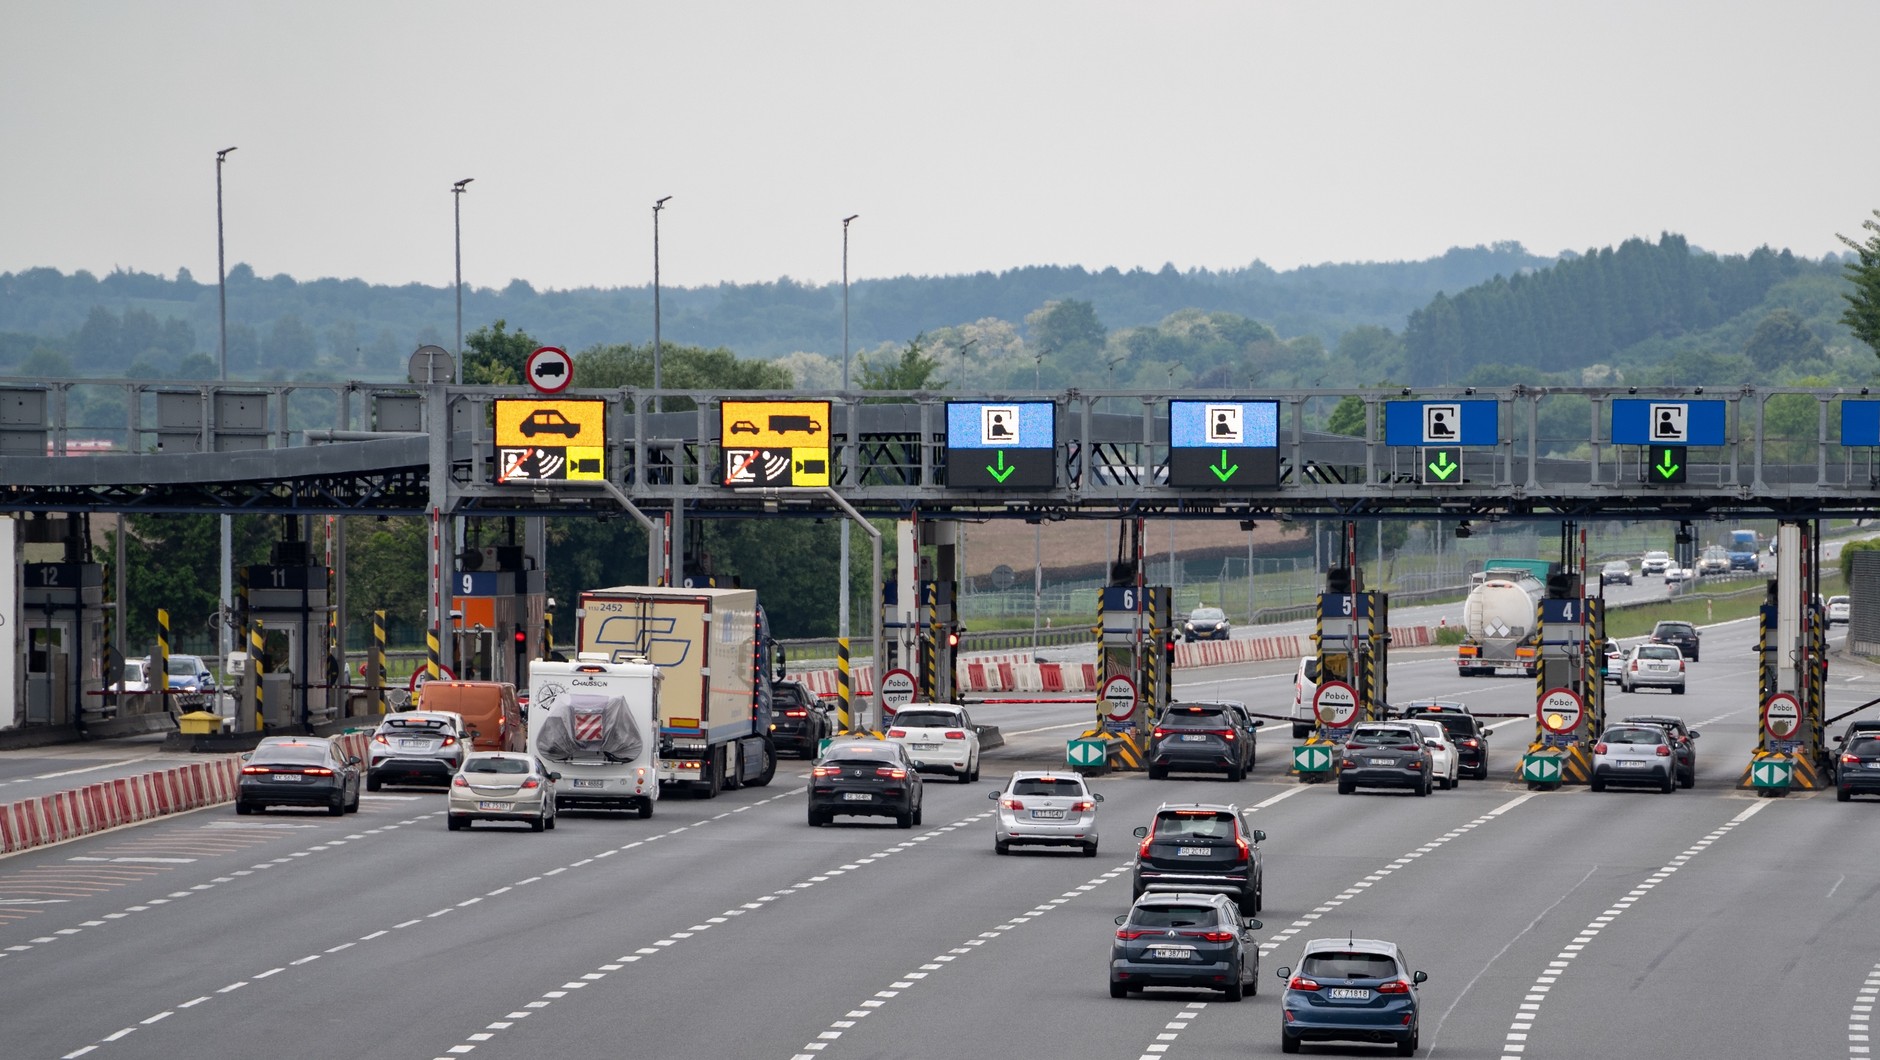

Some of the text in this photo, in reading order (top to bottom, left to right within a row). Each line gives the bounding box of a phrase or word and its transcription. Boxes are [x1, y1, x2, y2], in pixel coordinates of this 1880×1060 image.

[40, 566, 58, 585] 12
[270, 568, 285, 587] 11
[462, 574, 473, 594] 9
[1123, 589, 1134, 609] 6
[600, 603, 623, 612] 2452
[1342, 595, 1352, 615] 5
[1562, 601, 1573, 621] 4
[888, 679, 909, 688] Pobór
[1110, 685, 1130, 693] Pobór
[888, 694, 908, 703] opłat
[1325, 691, 1349, 700] Pobór
[1112, 700, 1129, 709] płat
[1549, 698, 1573, 706] Pobór
[1773, 703, 1793, 712] Pobór
[1333, 989, 1369, 998] KK 71818
